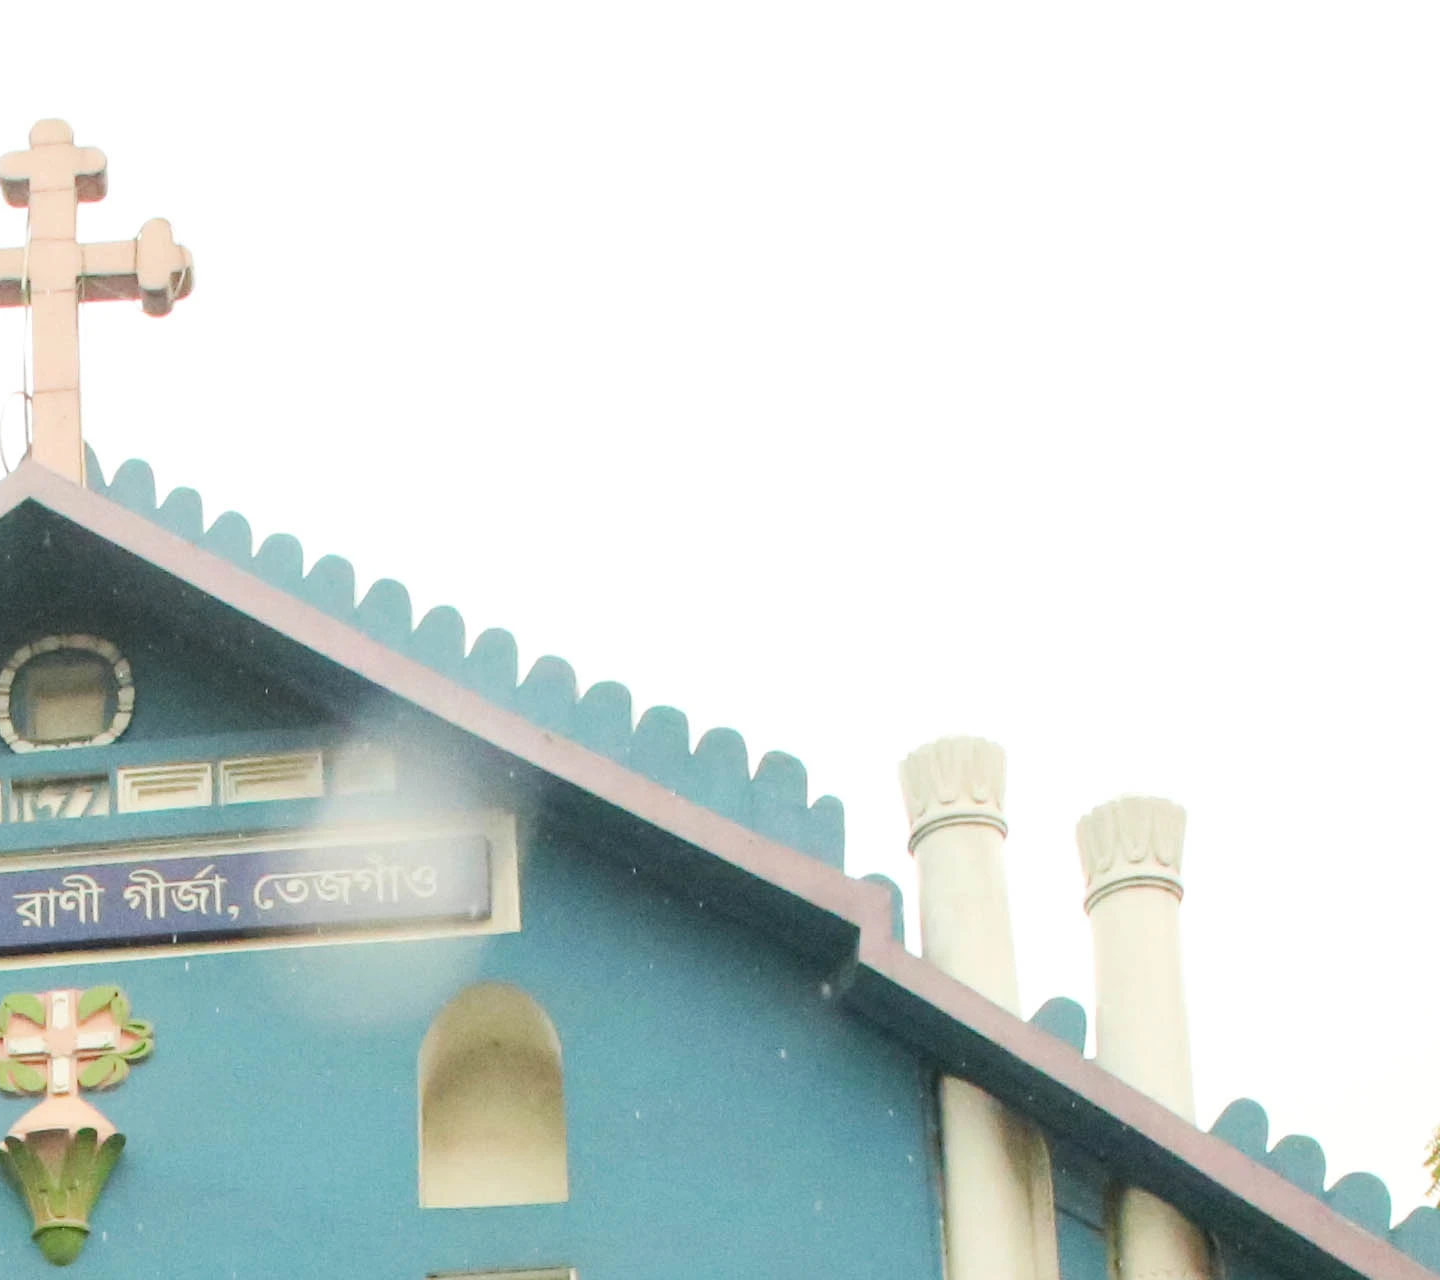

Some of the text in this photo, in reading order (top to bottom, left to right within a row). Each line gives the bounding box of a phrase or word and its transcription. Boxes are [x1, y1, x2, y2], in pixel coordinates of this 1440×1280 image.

[13, 874, 105, 928] রাণী
[124, 864, 240, 921] গীর্জা,
[253, 854, 438, 911] তেজগাঁও
